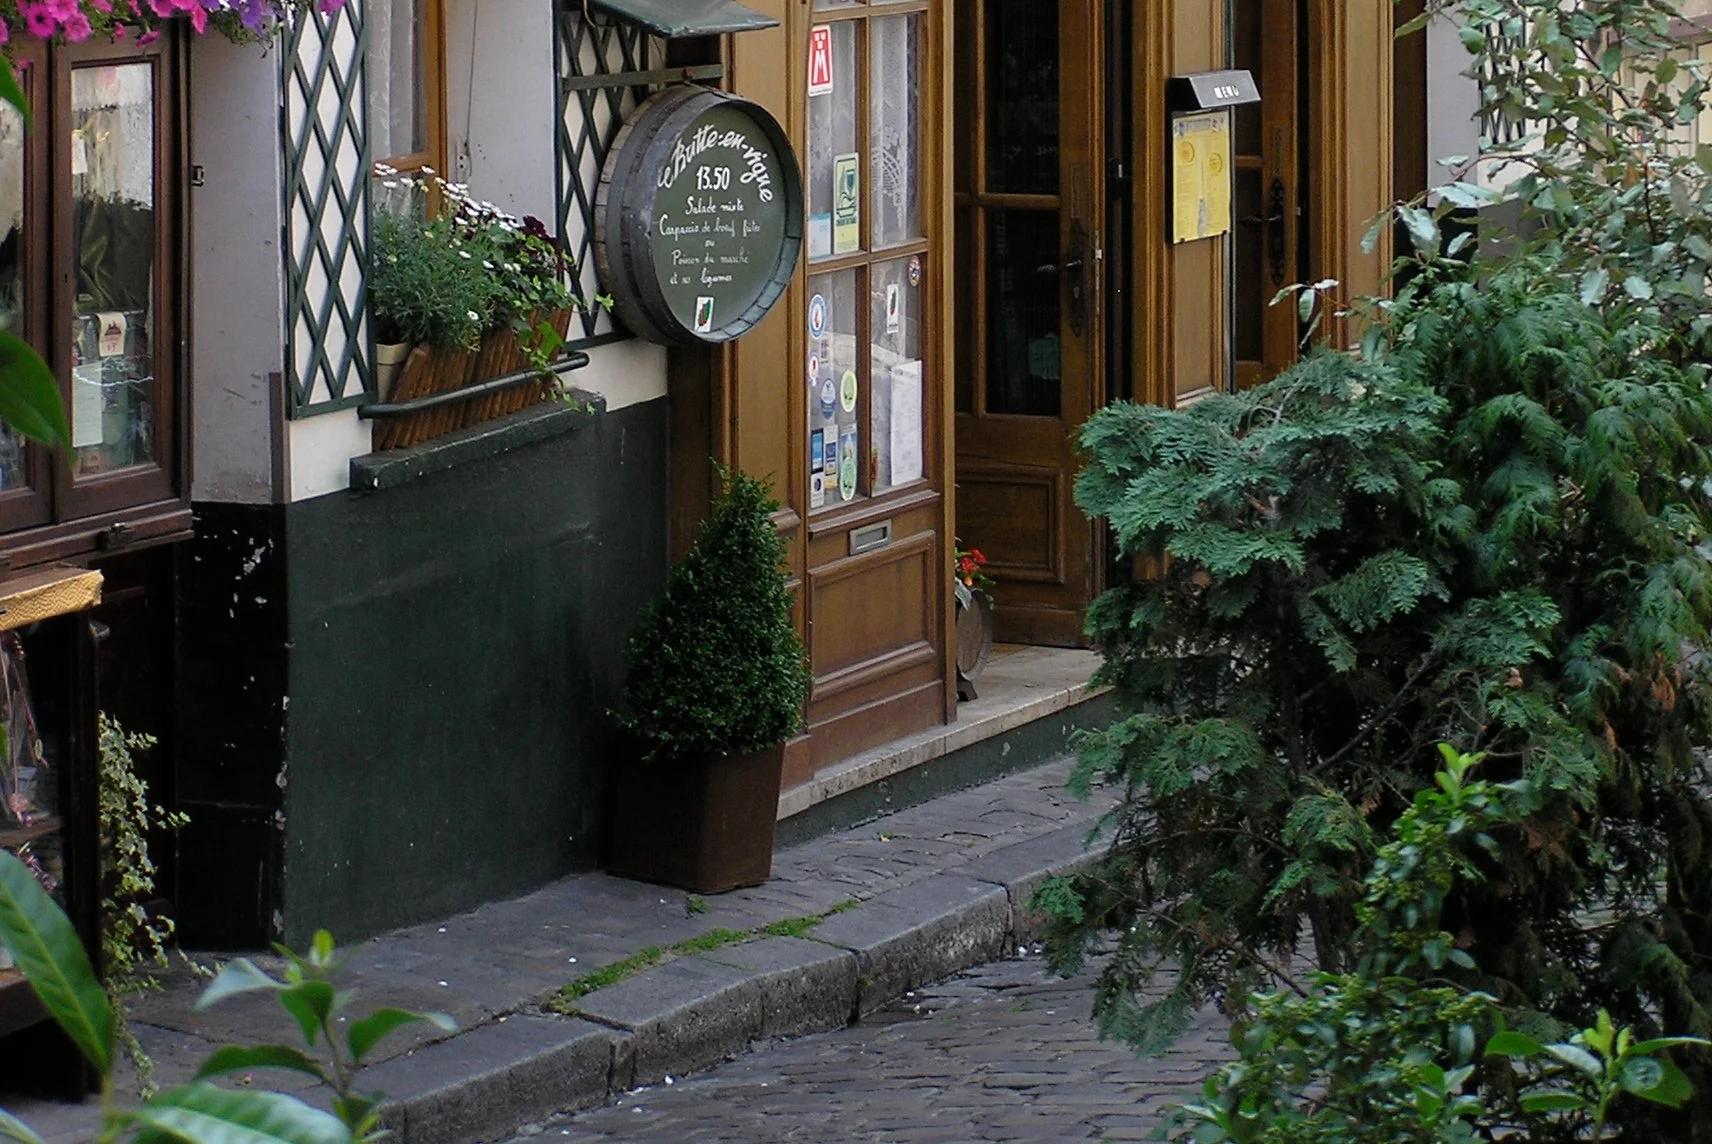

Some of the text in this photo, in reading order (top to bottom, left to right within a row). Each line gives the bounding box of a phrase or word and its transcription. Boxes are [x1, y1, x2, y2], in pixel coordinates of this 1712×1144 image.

[696, 165, 731, 191] 13.50
[685, 195, 717, 215] Salade
[701, 220, 711, 233] de
